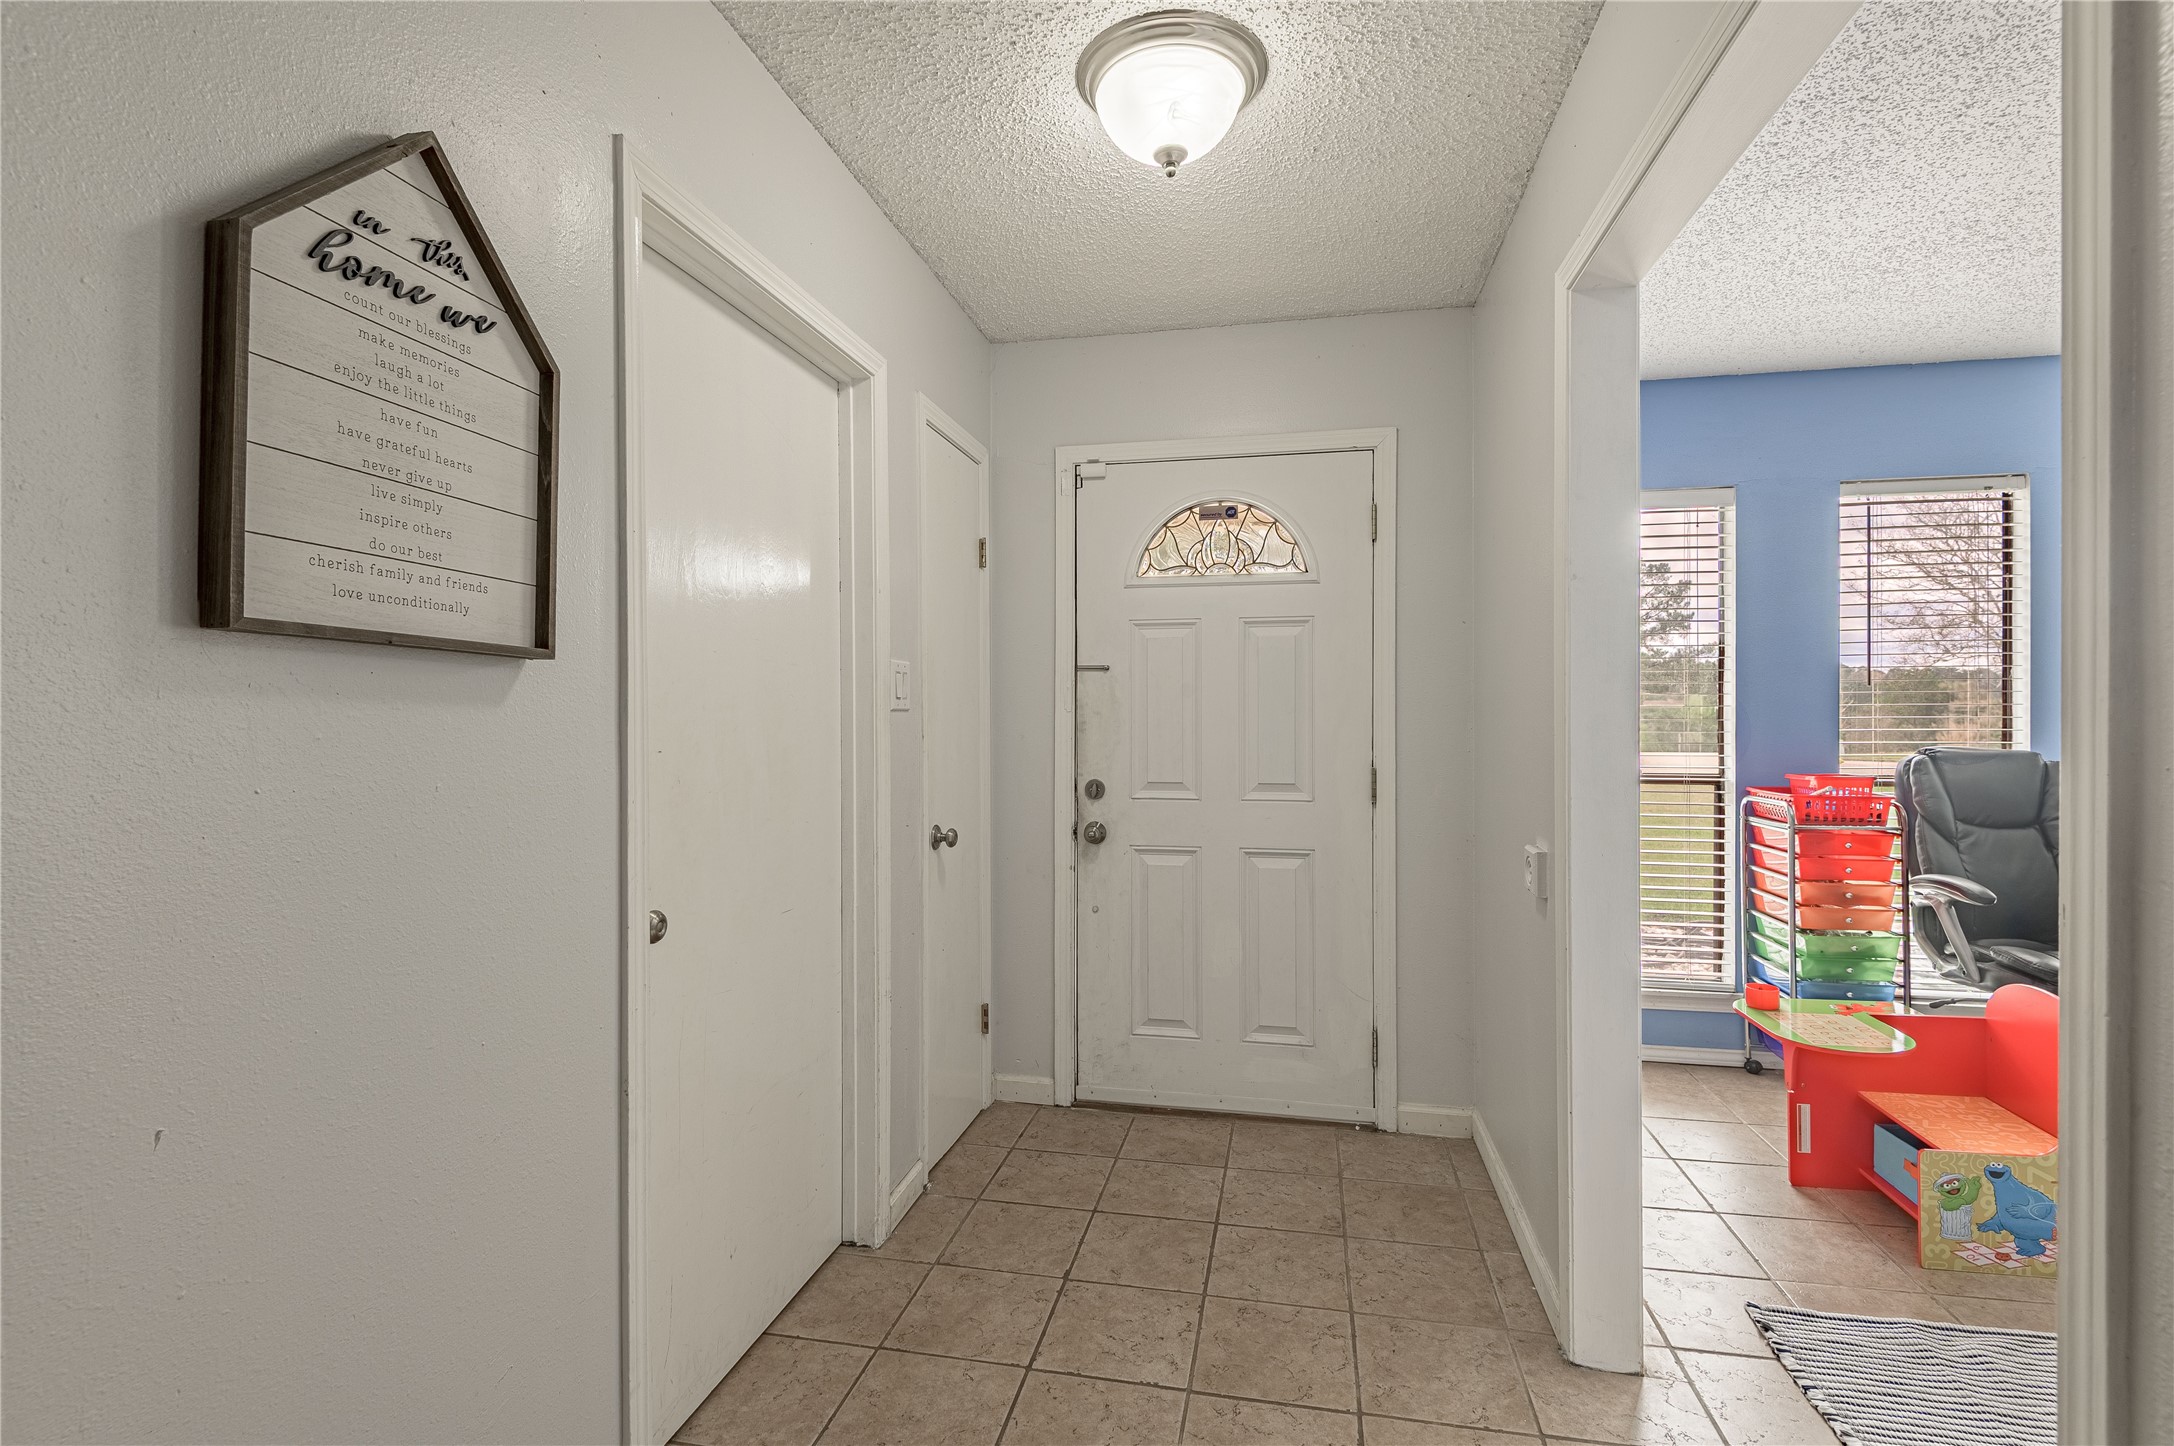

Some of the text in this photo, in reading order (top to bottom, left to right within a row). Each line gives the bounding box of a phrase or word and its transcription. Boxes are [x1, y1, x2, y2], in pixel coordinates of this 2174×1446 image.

[351, 209, 469, 281] in this
[307, 229, 497, 333] home we
[344, 291, 472, 355] count our blessings
[358, 328, 460, 377] make memories
[374, 353, 445, 392] laugh a lot
[334, 363, 477, 423] enjoy the little things
[380, 409, 438, 439] have fun
[337, 421, 473, 474] have grateful hearts
[362, 458, 453, 492] never give up
[370, 484, 443, 515] live simply
[359, 509, 453, 540] inspire others
[369, 537, 443, 562] do our best
[308, 554, 489, 594] cherish family and friends
[332, 584, 470, 616] love unconditionally
